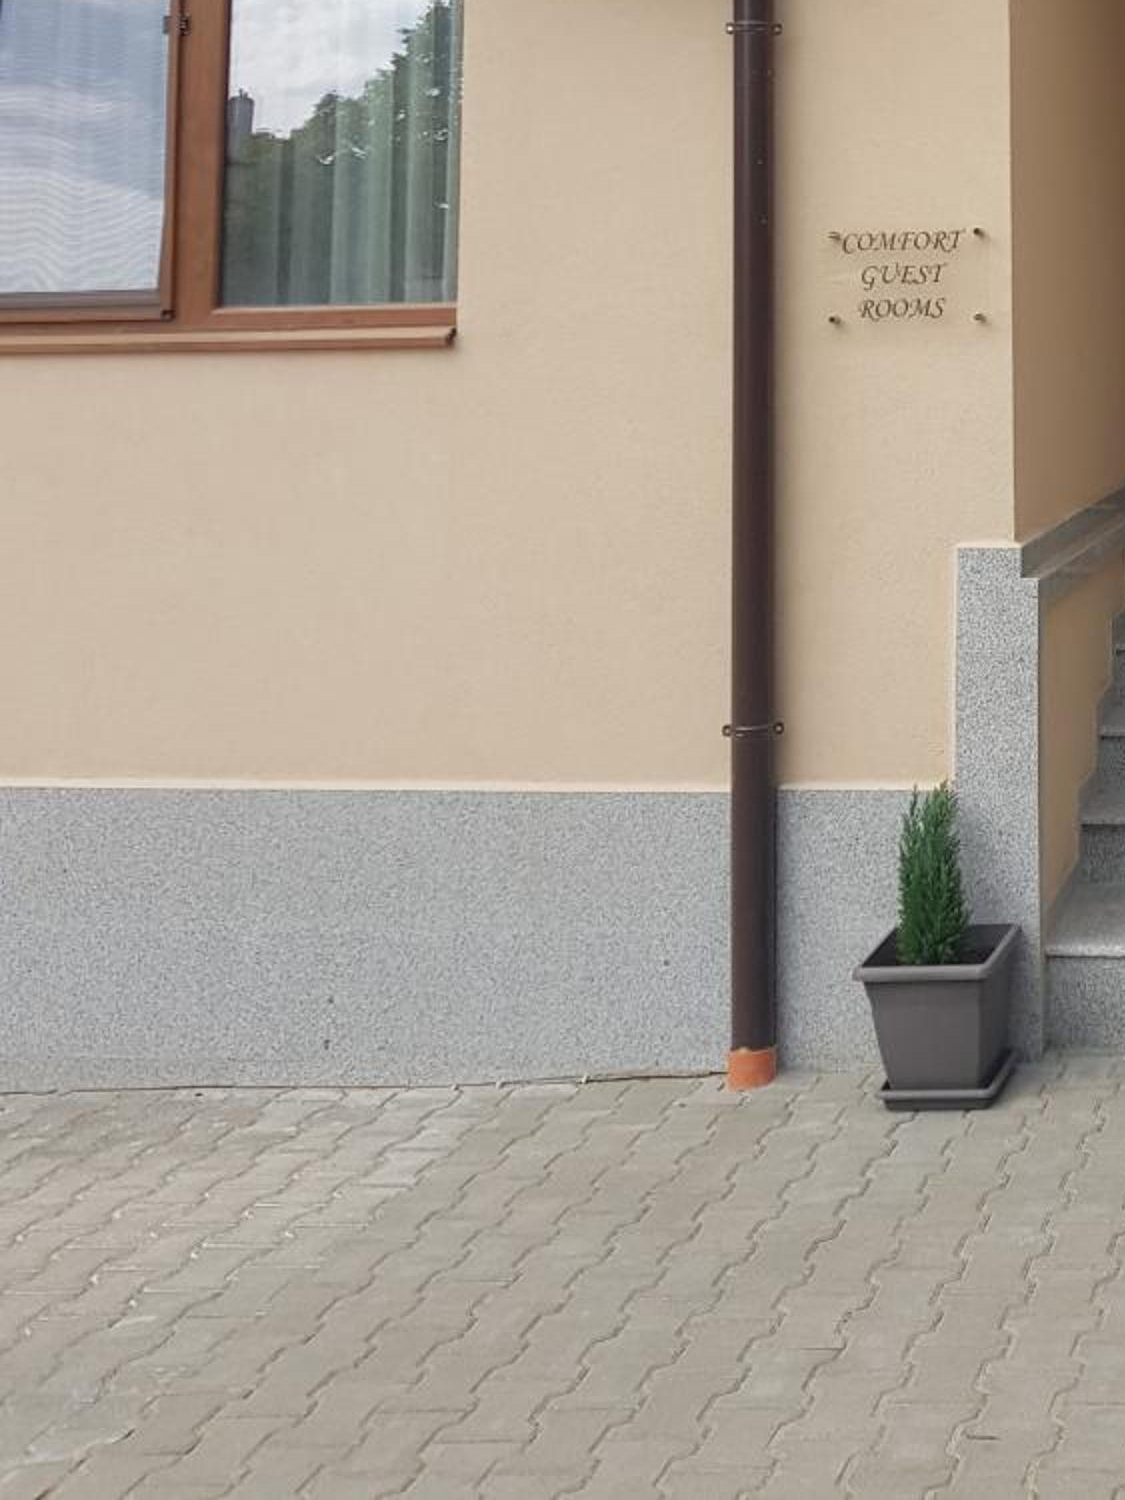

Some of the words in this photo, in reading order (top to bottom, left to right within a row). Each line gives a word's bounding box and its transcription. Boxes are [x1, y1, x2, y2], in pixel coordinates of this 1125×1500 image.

[842, 228, 966, 254] COMFORT
[861, 262, 949, 291] GUEST
[860, 298, 946, 322] ROOMS
